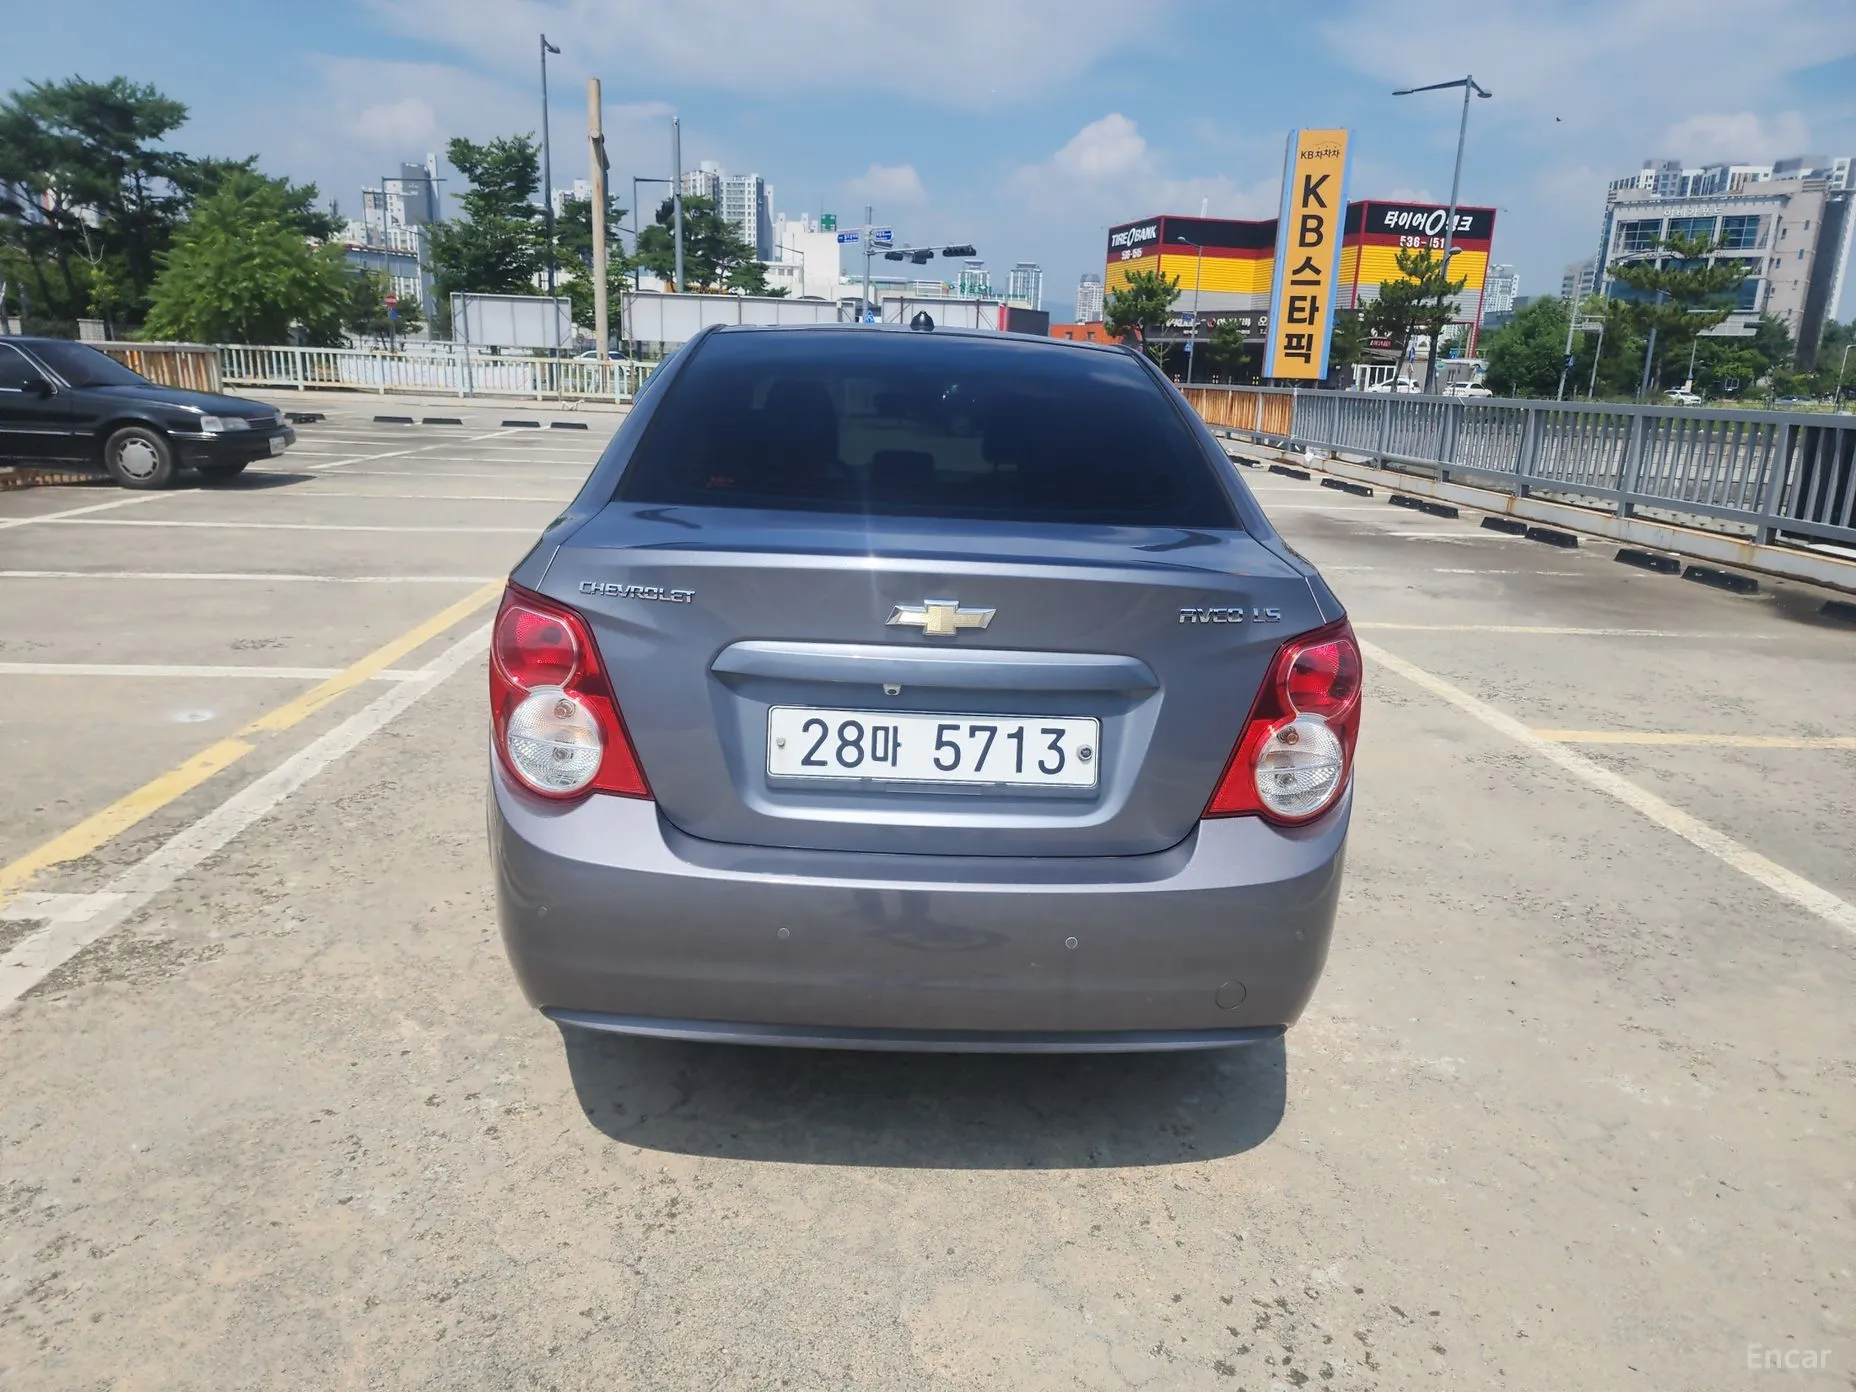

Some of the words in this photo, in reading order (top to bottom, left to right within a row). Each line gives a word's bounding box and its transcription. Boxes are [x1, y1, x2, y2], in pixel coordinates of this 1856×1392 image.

[1300, 151, 1314, 159] KB
[1315, 145, 1340, 159] 차차차
[1284, 174, 1331, 364] KB스타픽
[578, 581, 696, 604] CHEVROLET
[1179, 608, 1244, 624] AVEO
[801, 718, 902, 768] 28마
[933, 724, 1066, 775] 5713
